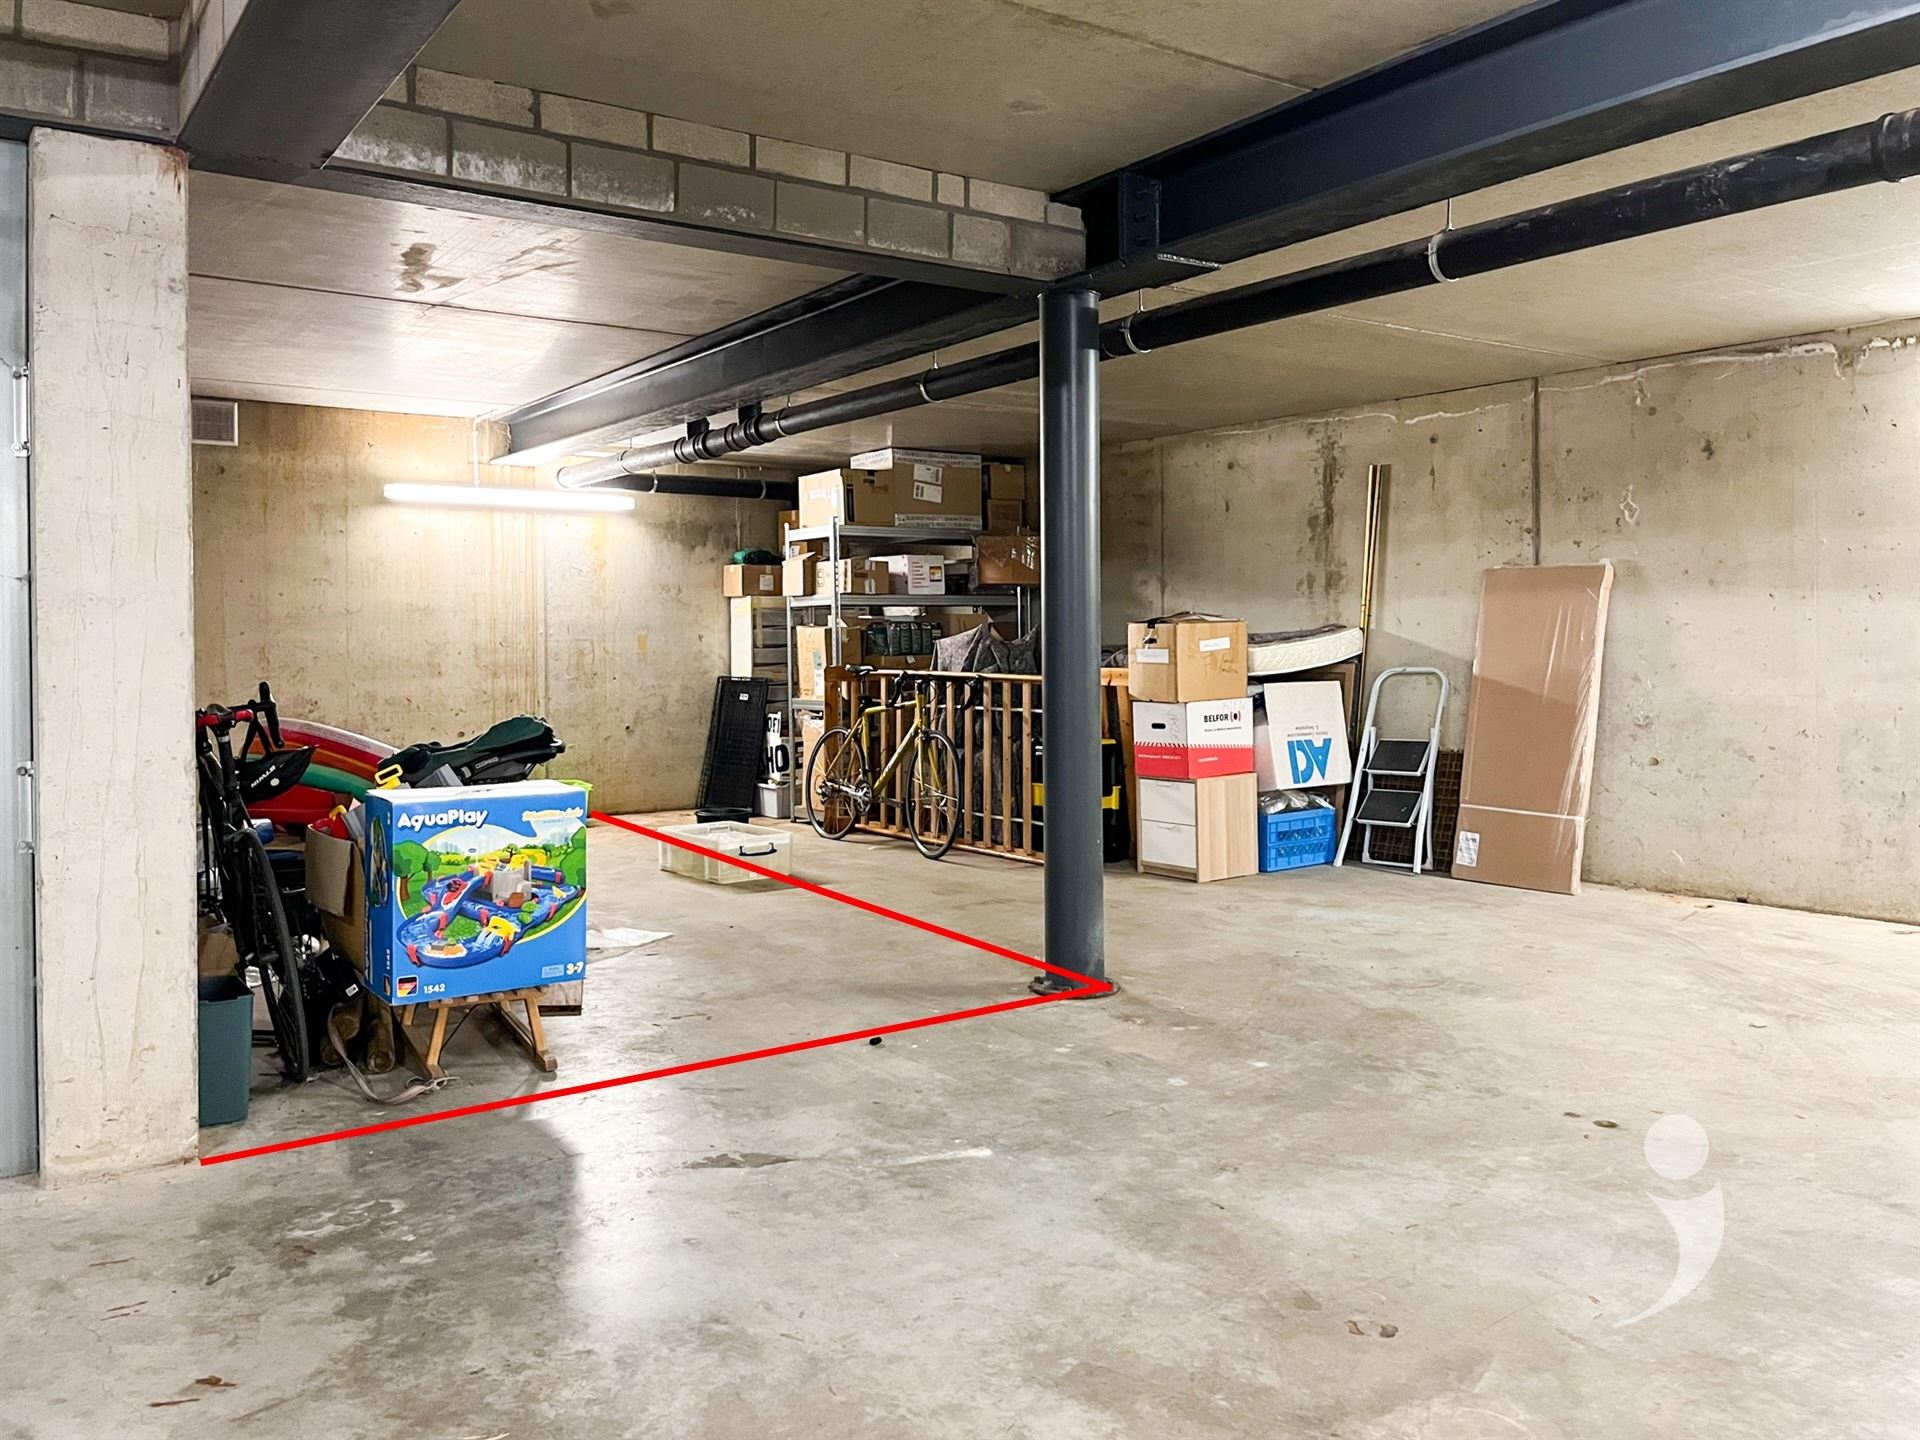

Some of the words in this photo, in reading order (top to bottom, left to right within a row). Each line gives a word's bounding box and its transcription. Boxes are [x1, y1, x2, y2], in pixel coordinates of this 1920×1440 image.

[1203, 713, 1229, 723] BELFOR
[397, 808, 488, 832] AquaPlay
[566, 961, 584, 976] 3-7
[423, 983, 446, 995] 1542
